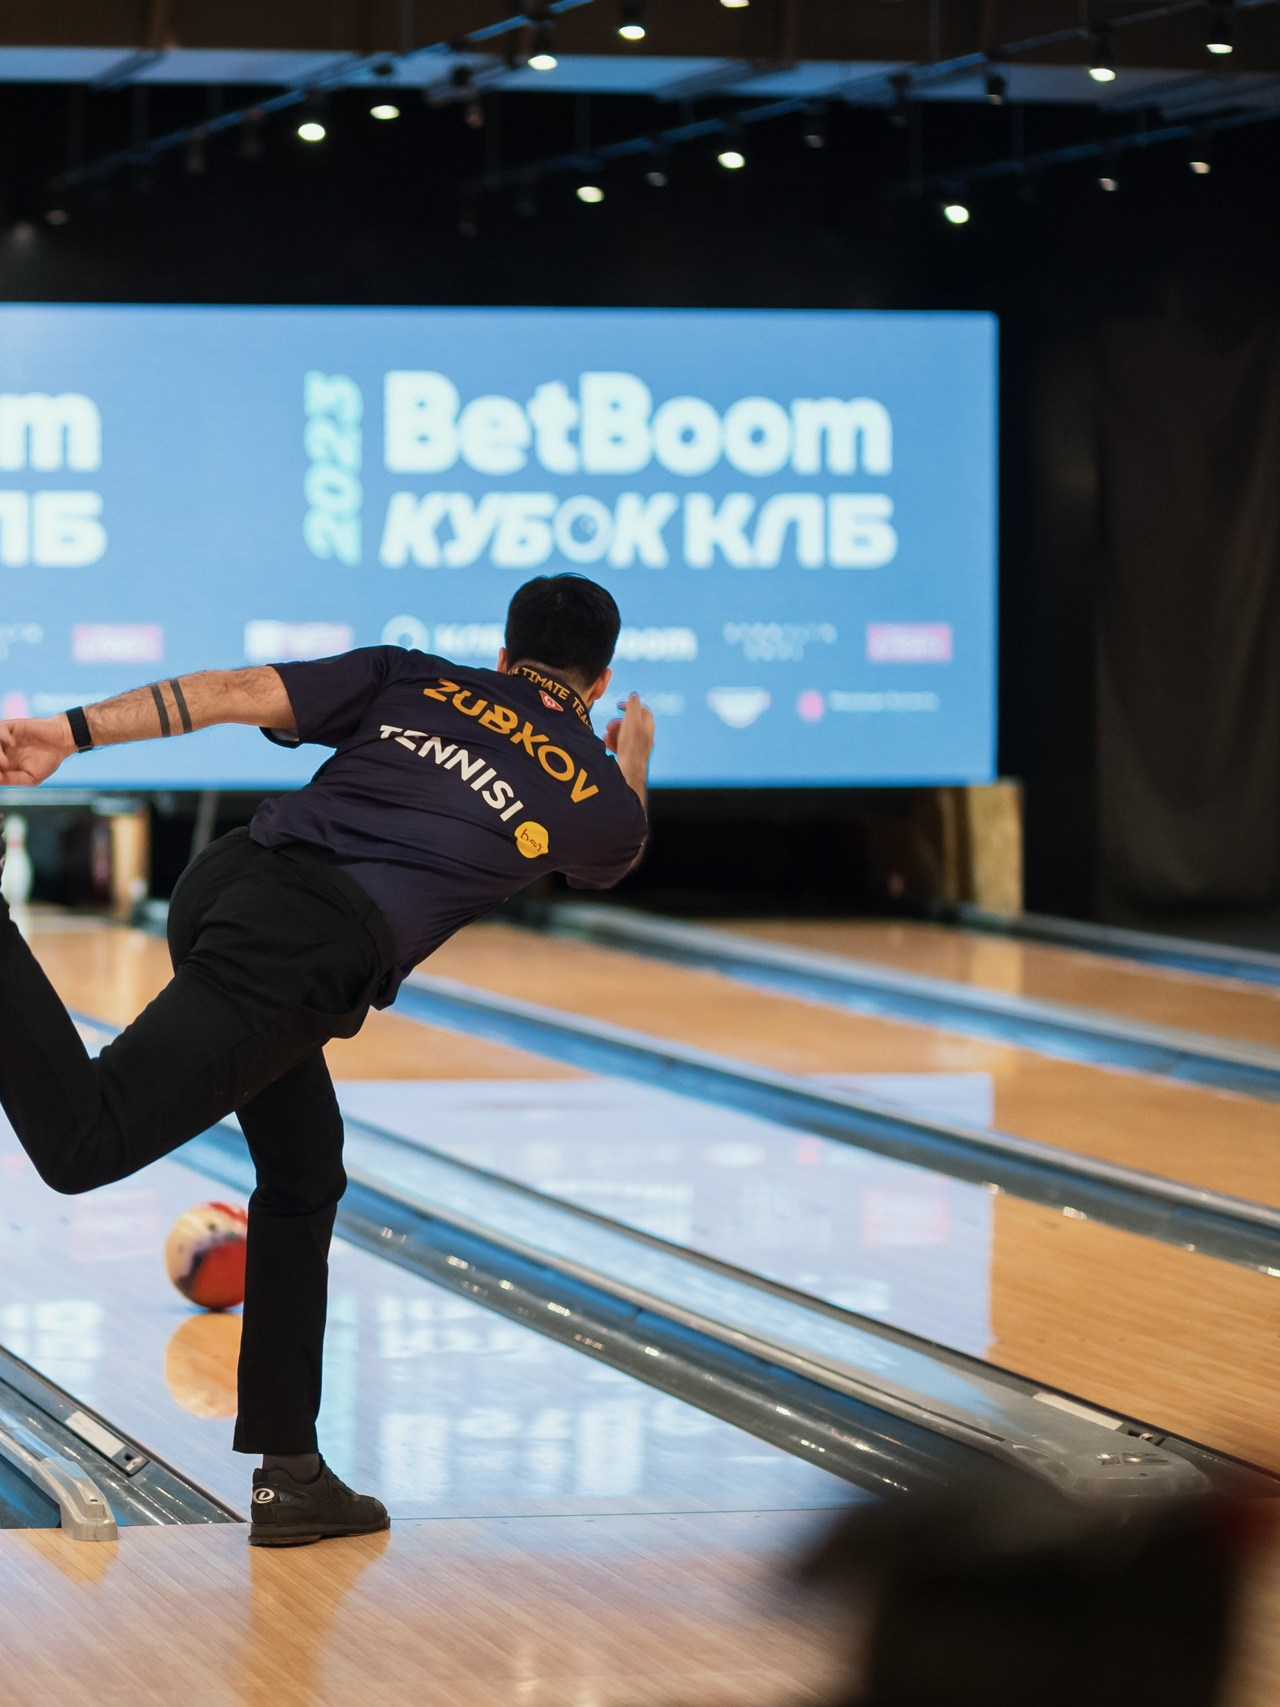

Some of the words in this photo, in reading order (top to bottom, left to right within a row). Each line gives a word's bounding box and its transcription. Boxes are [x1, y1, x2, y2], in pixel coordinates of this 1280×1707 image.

[303, 369, 363, 565] 2023
[382, 369, 894, 476] BetBoom
[379, 492, 680, 569] КУБОК
[683, 492, 899, 569] КЛБ
[379, 724, 524, 822] TENNISI
[423, 677, 600, 804] ZUBKOV
